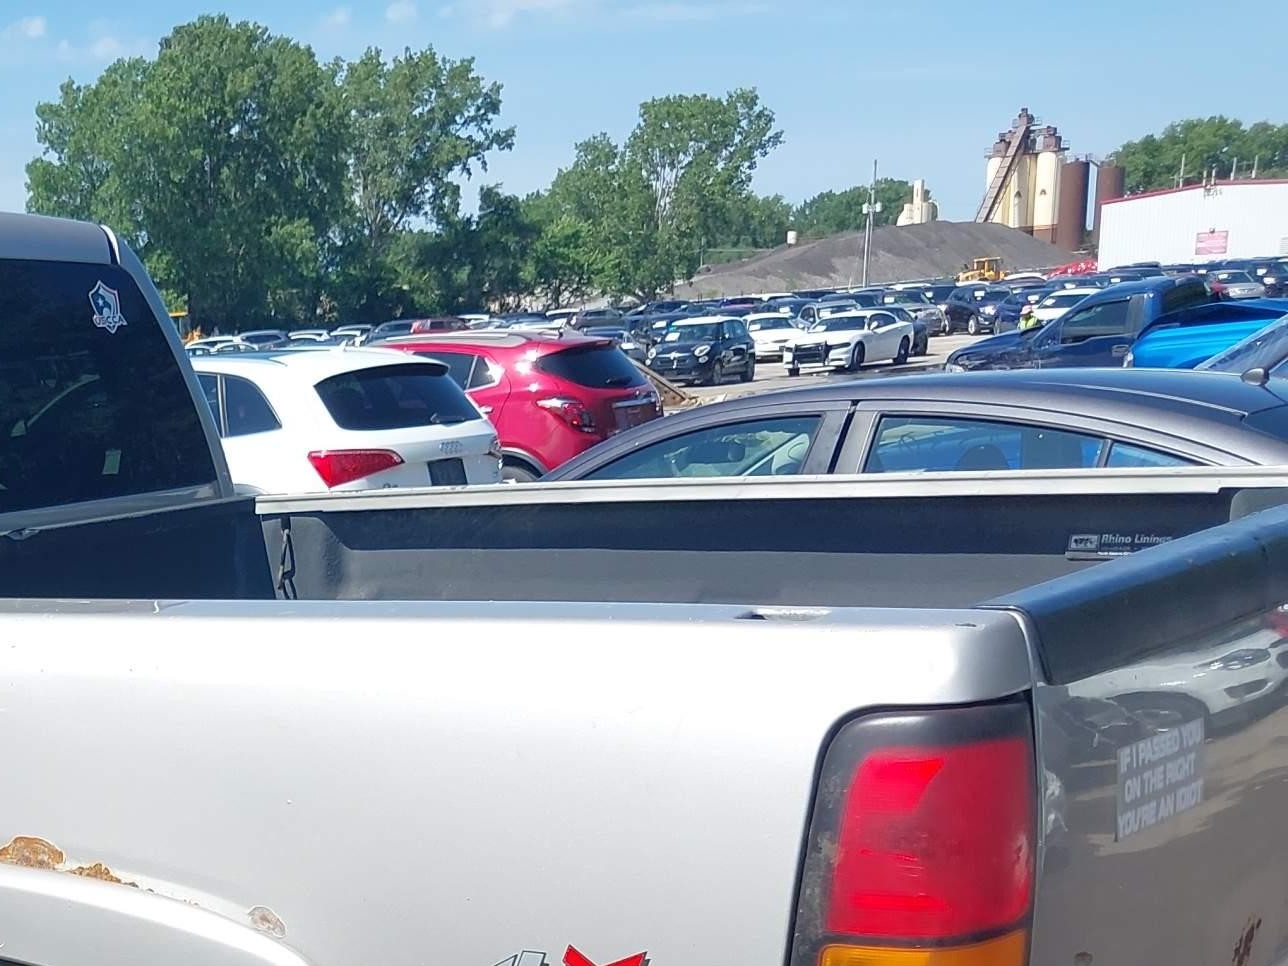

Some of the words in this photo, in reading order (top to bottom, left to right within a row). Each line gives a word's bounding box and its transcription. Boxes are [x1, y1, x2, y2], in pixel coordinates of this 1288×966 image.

[1101, 533, 1132, 544] Rhino
[1138, 727, 1181, 767] PASSED
[1180, 718, 1203, 750] YOU
[1124, 774, 1142, 804] ON
[1142, 764, 1165, 795] THE
[1165, 752, 1197, 786] RIGHT
[1158, 791, 1176, 820] AN
